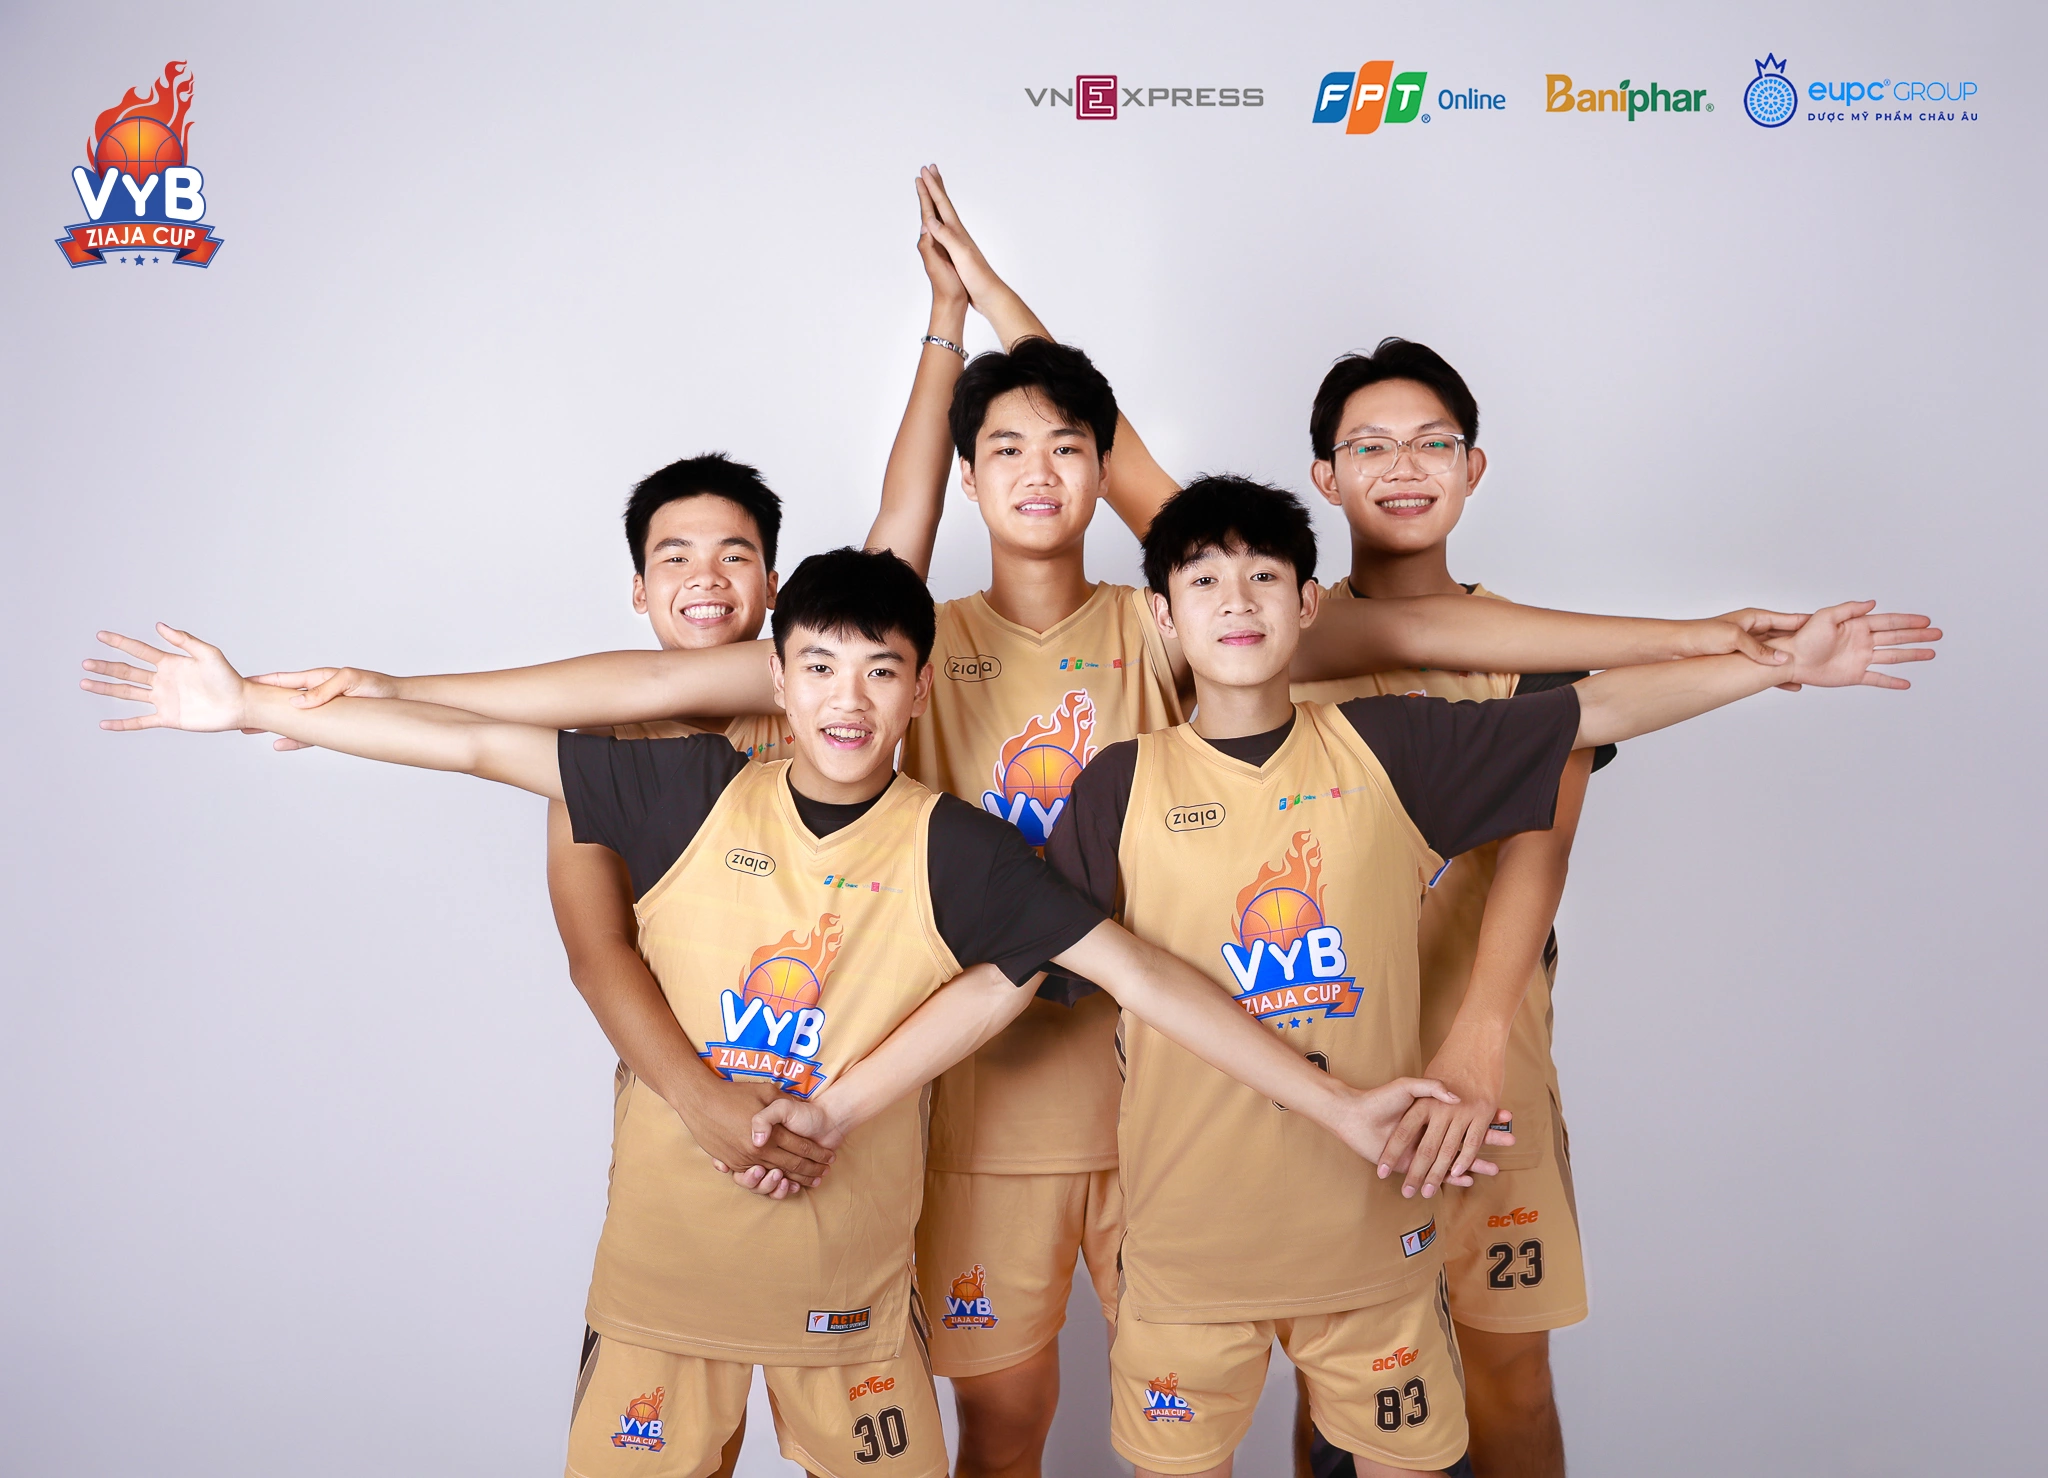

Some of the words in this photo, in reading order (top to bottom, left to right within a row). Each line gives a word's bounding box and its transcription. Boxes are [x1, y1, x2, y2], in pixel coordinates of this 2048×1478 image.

[951, 660, 993, 679] ziaja
[983, 791, 1064, 839] VY
[1172, 808, 1218, 826] ziaja
[731, 853, 769, 873] ziaja
[1221, 926, 1347, 992] VYB
[1241, 990, 1299, 1016] ZIAJA
[1303, 983, 1342, 1004] CUP
[720, 989, 825, 1058] VYB
[719, 1049, 772, 1072] ZIAJA
[773, 1059, 805, 1080] CUP
[1486, 1237, 1544, 1291] 23
[945, 1296, 992, 1315] VYB
[831, 1311, 868, 1325] ACTEE
[950, 1316, 972, 1324] ZIAJA
[972, 1316, 989, 1324] CUP
[1145, 1389, 1189, 1408] VYB
[1374, 1375, 1431, 1433] 83
[1149, 1409, 1170, 1417] ZIAJA
[1170, 1409, 1186, 1417] CUP
[620, 1414, 664, 1438] VYB
[851, 1404, 911, 1466] 30
[620, 1434, 641, 1444] ZIAJA
[642, 1437, 659, 1446] CUP
